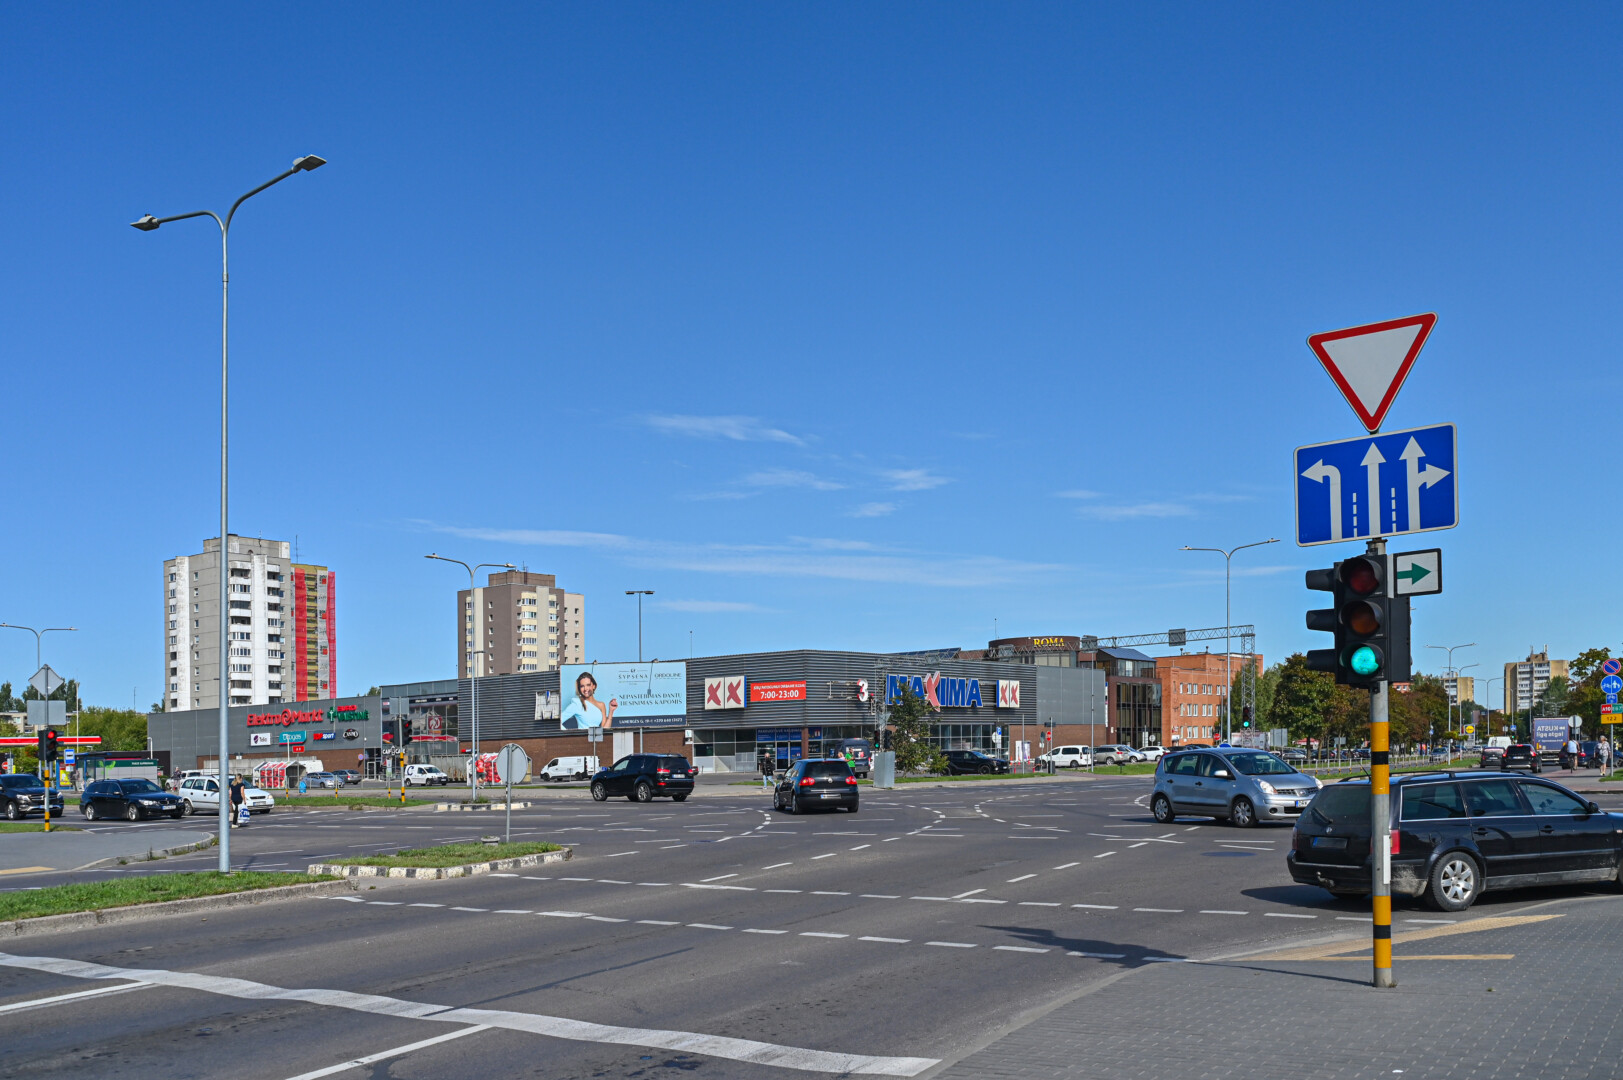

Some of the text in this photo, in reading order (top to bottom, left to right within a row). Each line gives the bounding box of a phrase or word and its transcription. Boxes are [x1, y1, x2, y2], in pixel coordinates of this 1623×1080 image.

[1033, 638, 1064, 647] ROMA
[760, 690, 799, 699] 7:00-23:00
[887, 671, 983, 712] MAXIMA
[282, 733, 301, 741] Drogas
